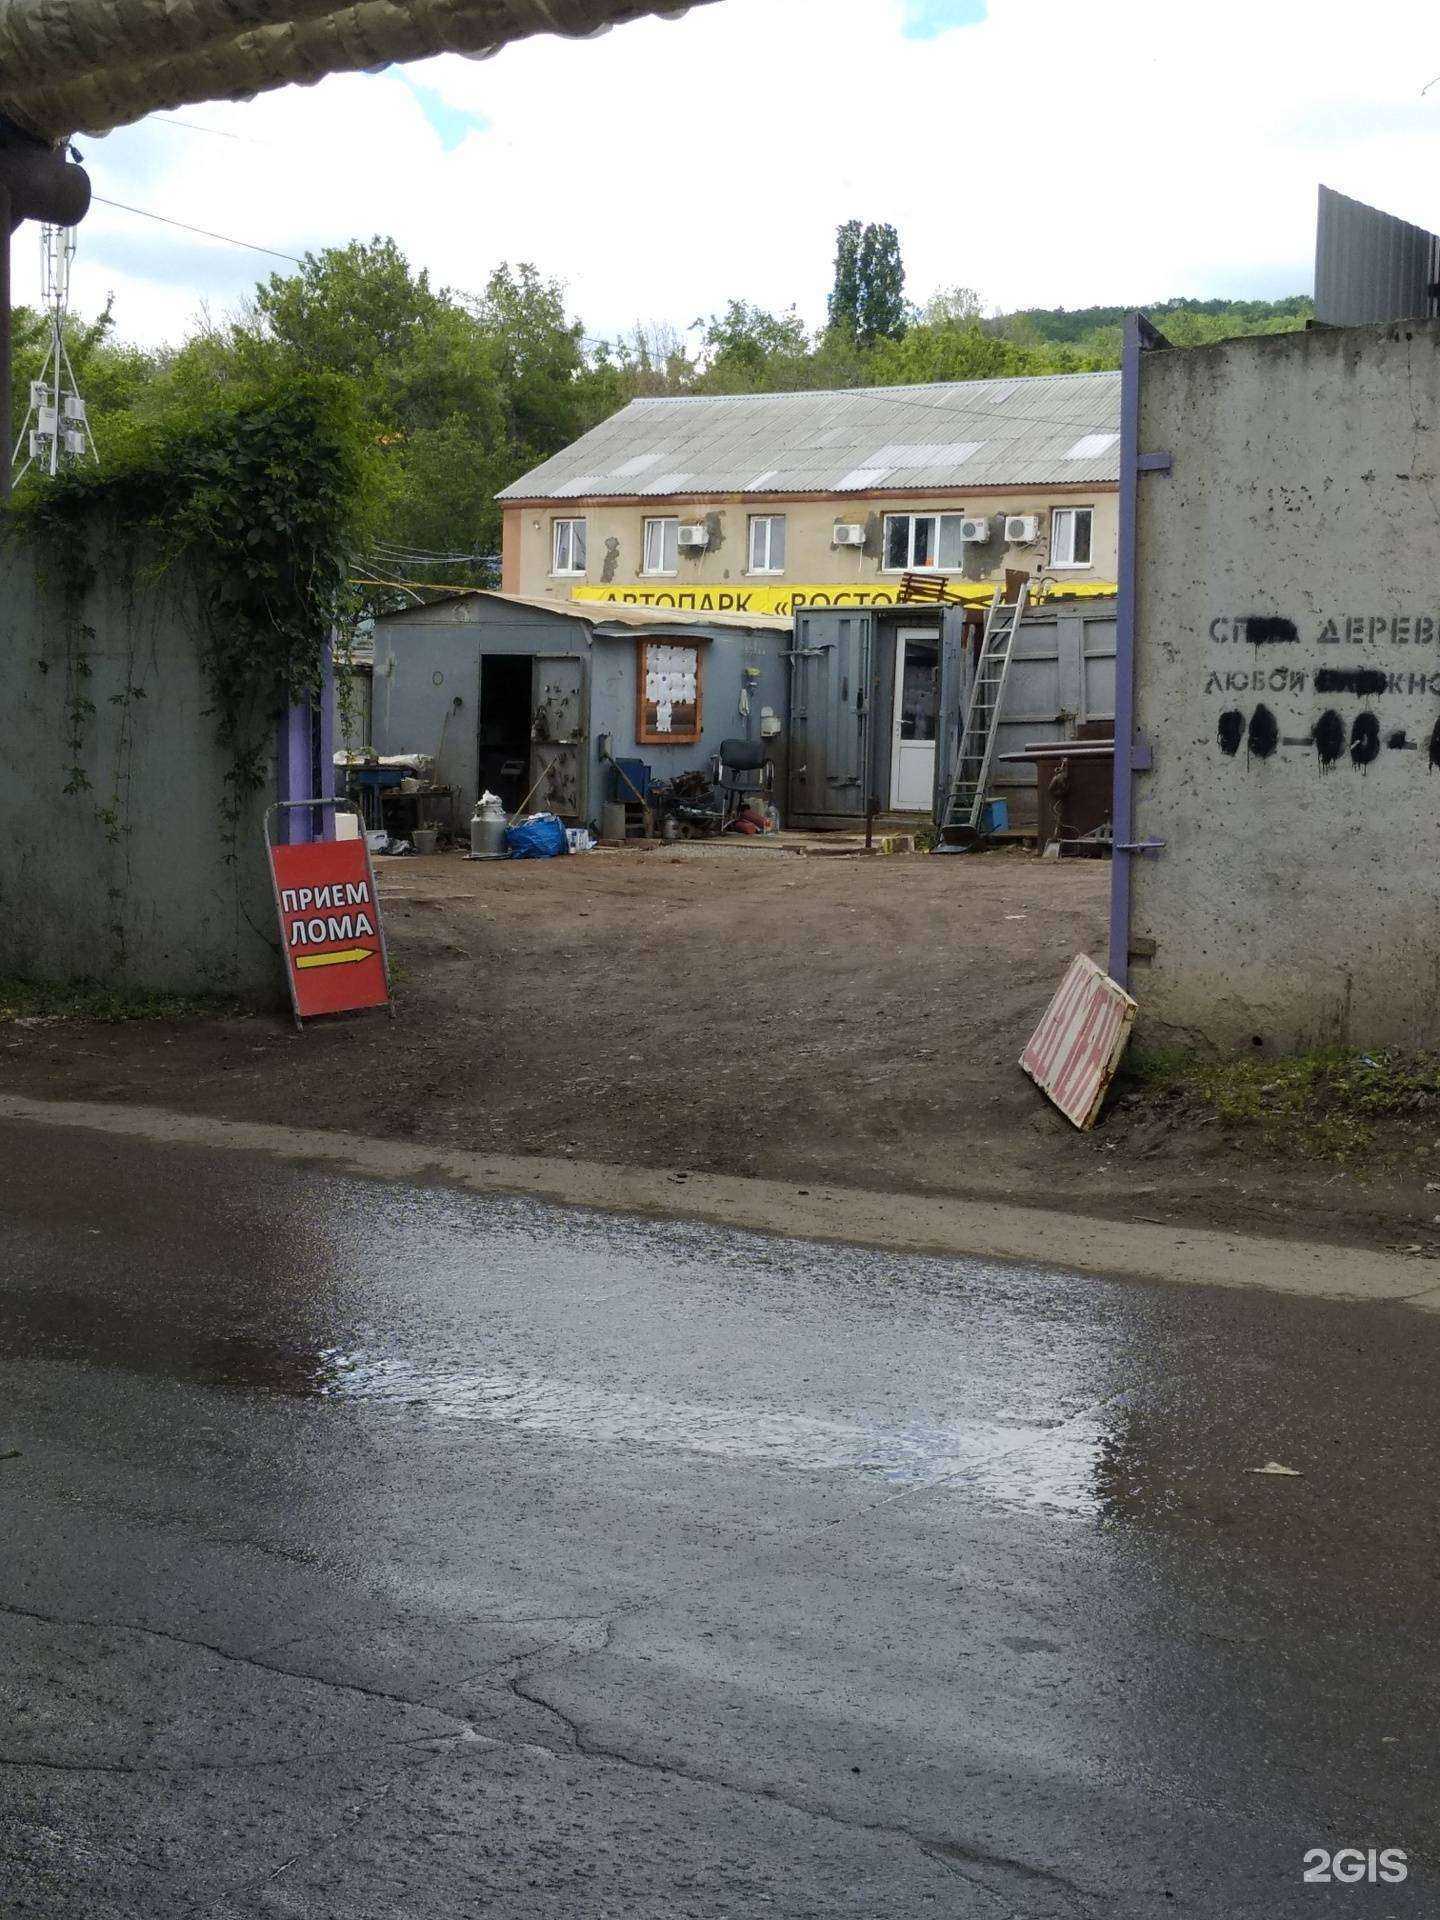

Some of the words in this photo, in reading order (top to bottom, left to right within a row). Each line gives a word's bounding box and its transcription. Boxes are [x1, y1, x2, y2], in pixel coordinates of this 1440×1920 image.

[1316, 615, 1440, 645] ДЕРЕВ
[1205, 666, 1305, 695] ЛЮБОЙ
[281, 881, 370, 912] ПРИЕМ
[290, 913, 375, 946] ЛОМА
